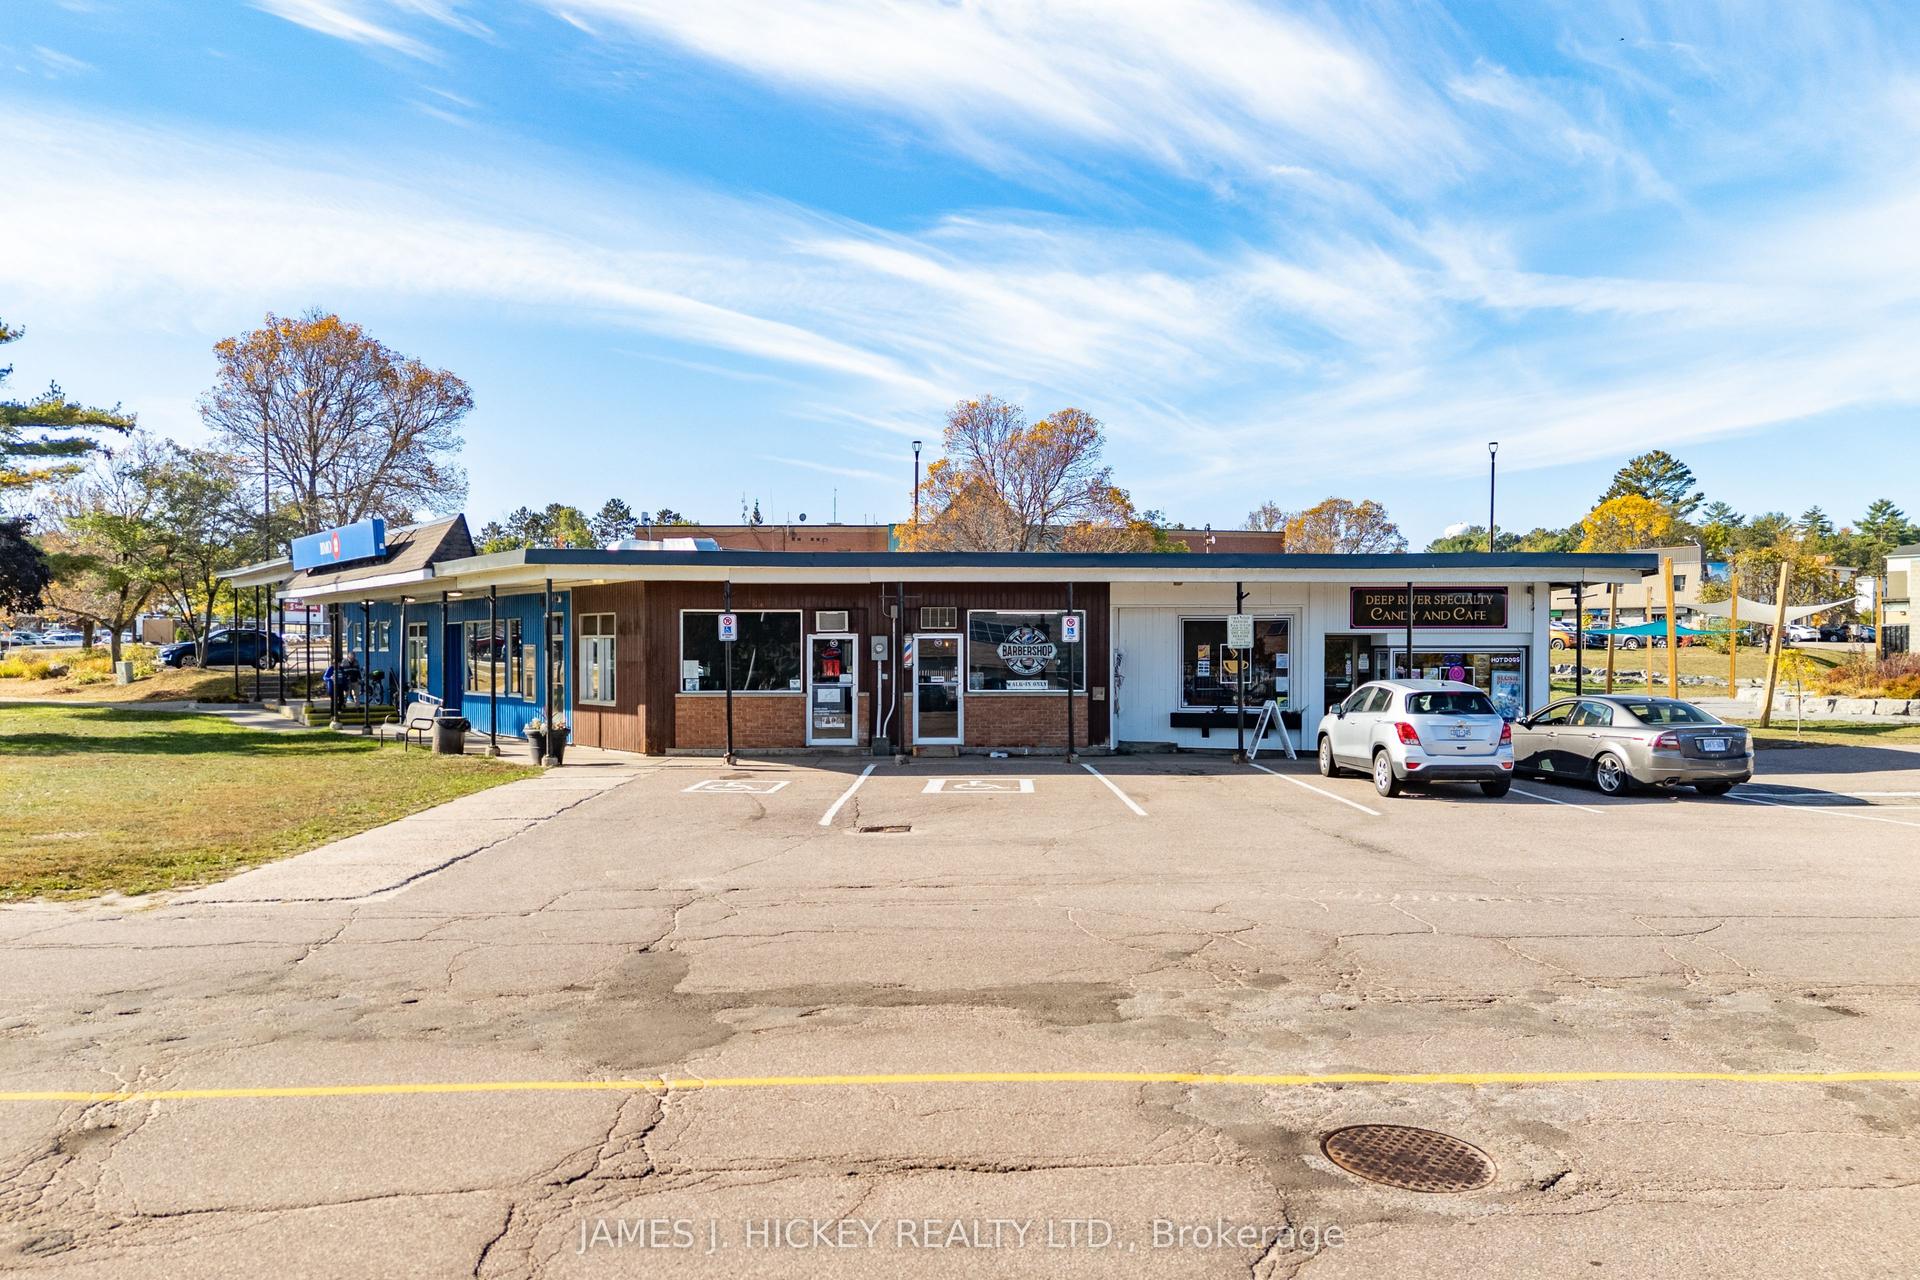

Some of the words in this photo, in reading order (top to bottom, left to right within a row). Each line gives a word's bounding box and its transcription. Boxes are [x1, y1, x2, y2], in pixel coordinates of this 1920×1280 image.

[1366, 595, 1395, 605] DEEP
[1434, 595, 1493, 605] SPECIALTY
[1423, 611, 1450, 620] AND
[1002, 645, 1053, 656] BARBERSHOP
